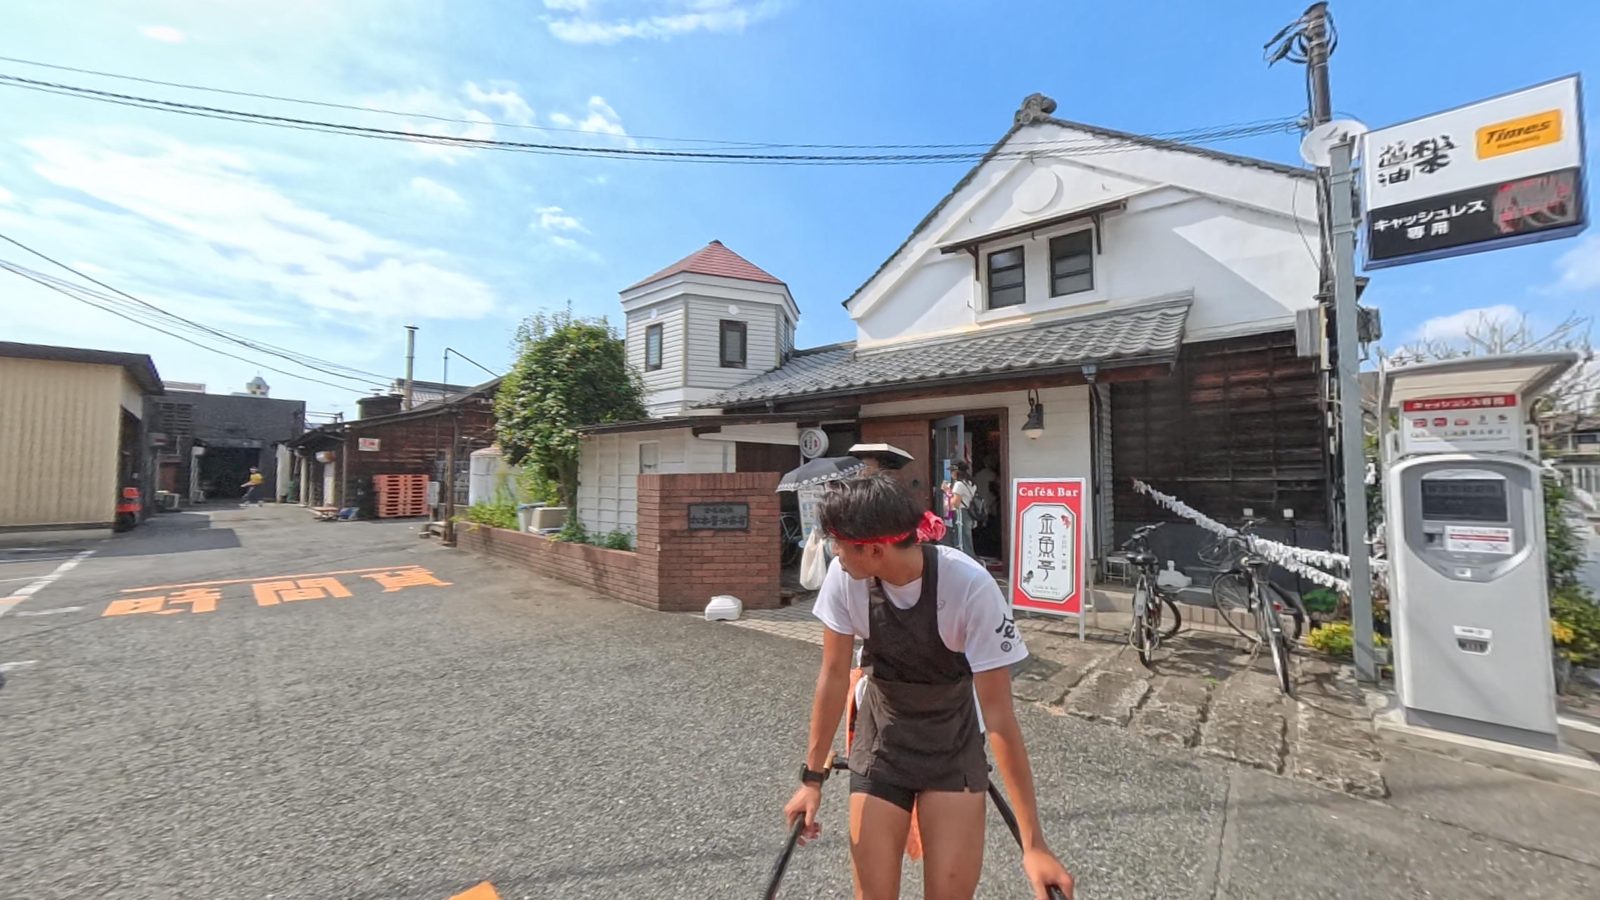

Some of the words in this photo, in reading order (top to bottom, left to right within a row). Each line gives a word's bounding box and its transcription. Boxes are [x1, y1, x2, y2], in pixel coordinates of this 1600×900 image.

[1484, 119, 1553, 145] Times
[1373, 199, 1487, 232] キャッシュレス
[1406, 220, 1449, 239] 専用
[1057, 487, 1079, 497] Bar
[101, 566, 454, 617] 時間貸
